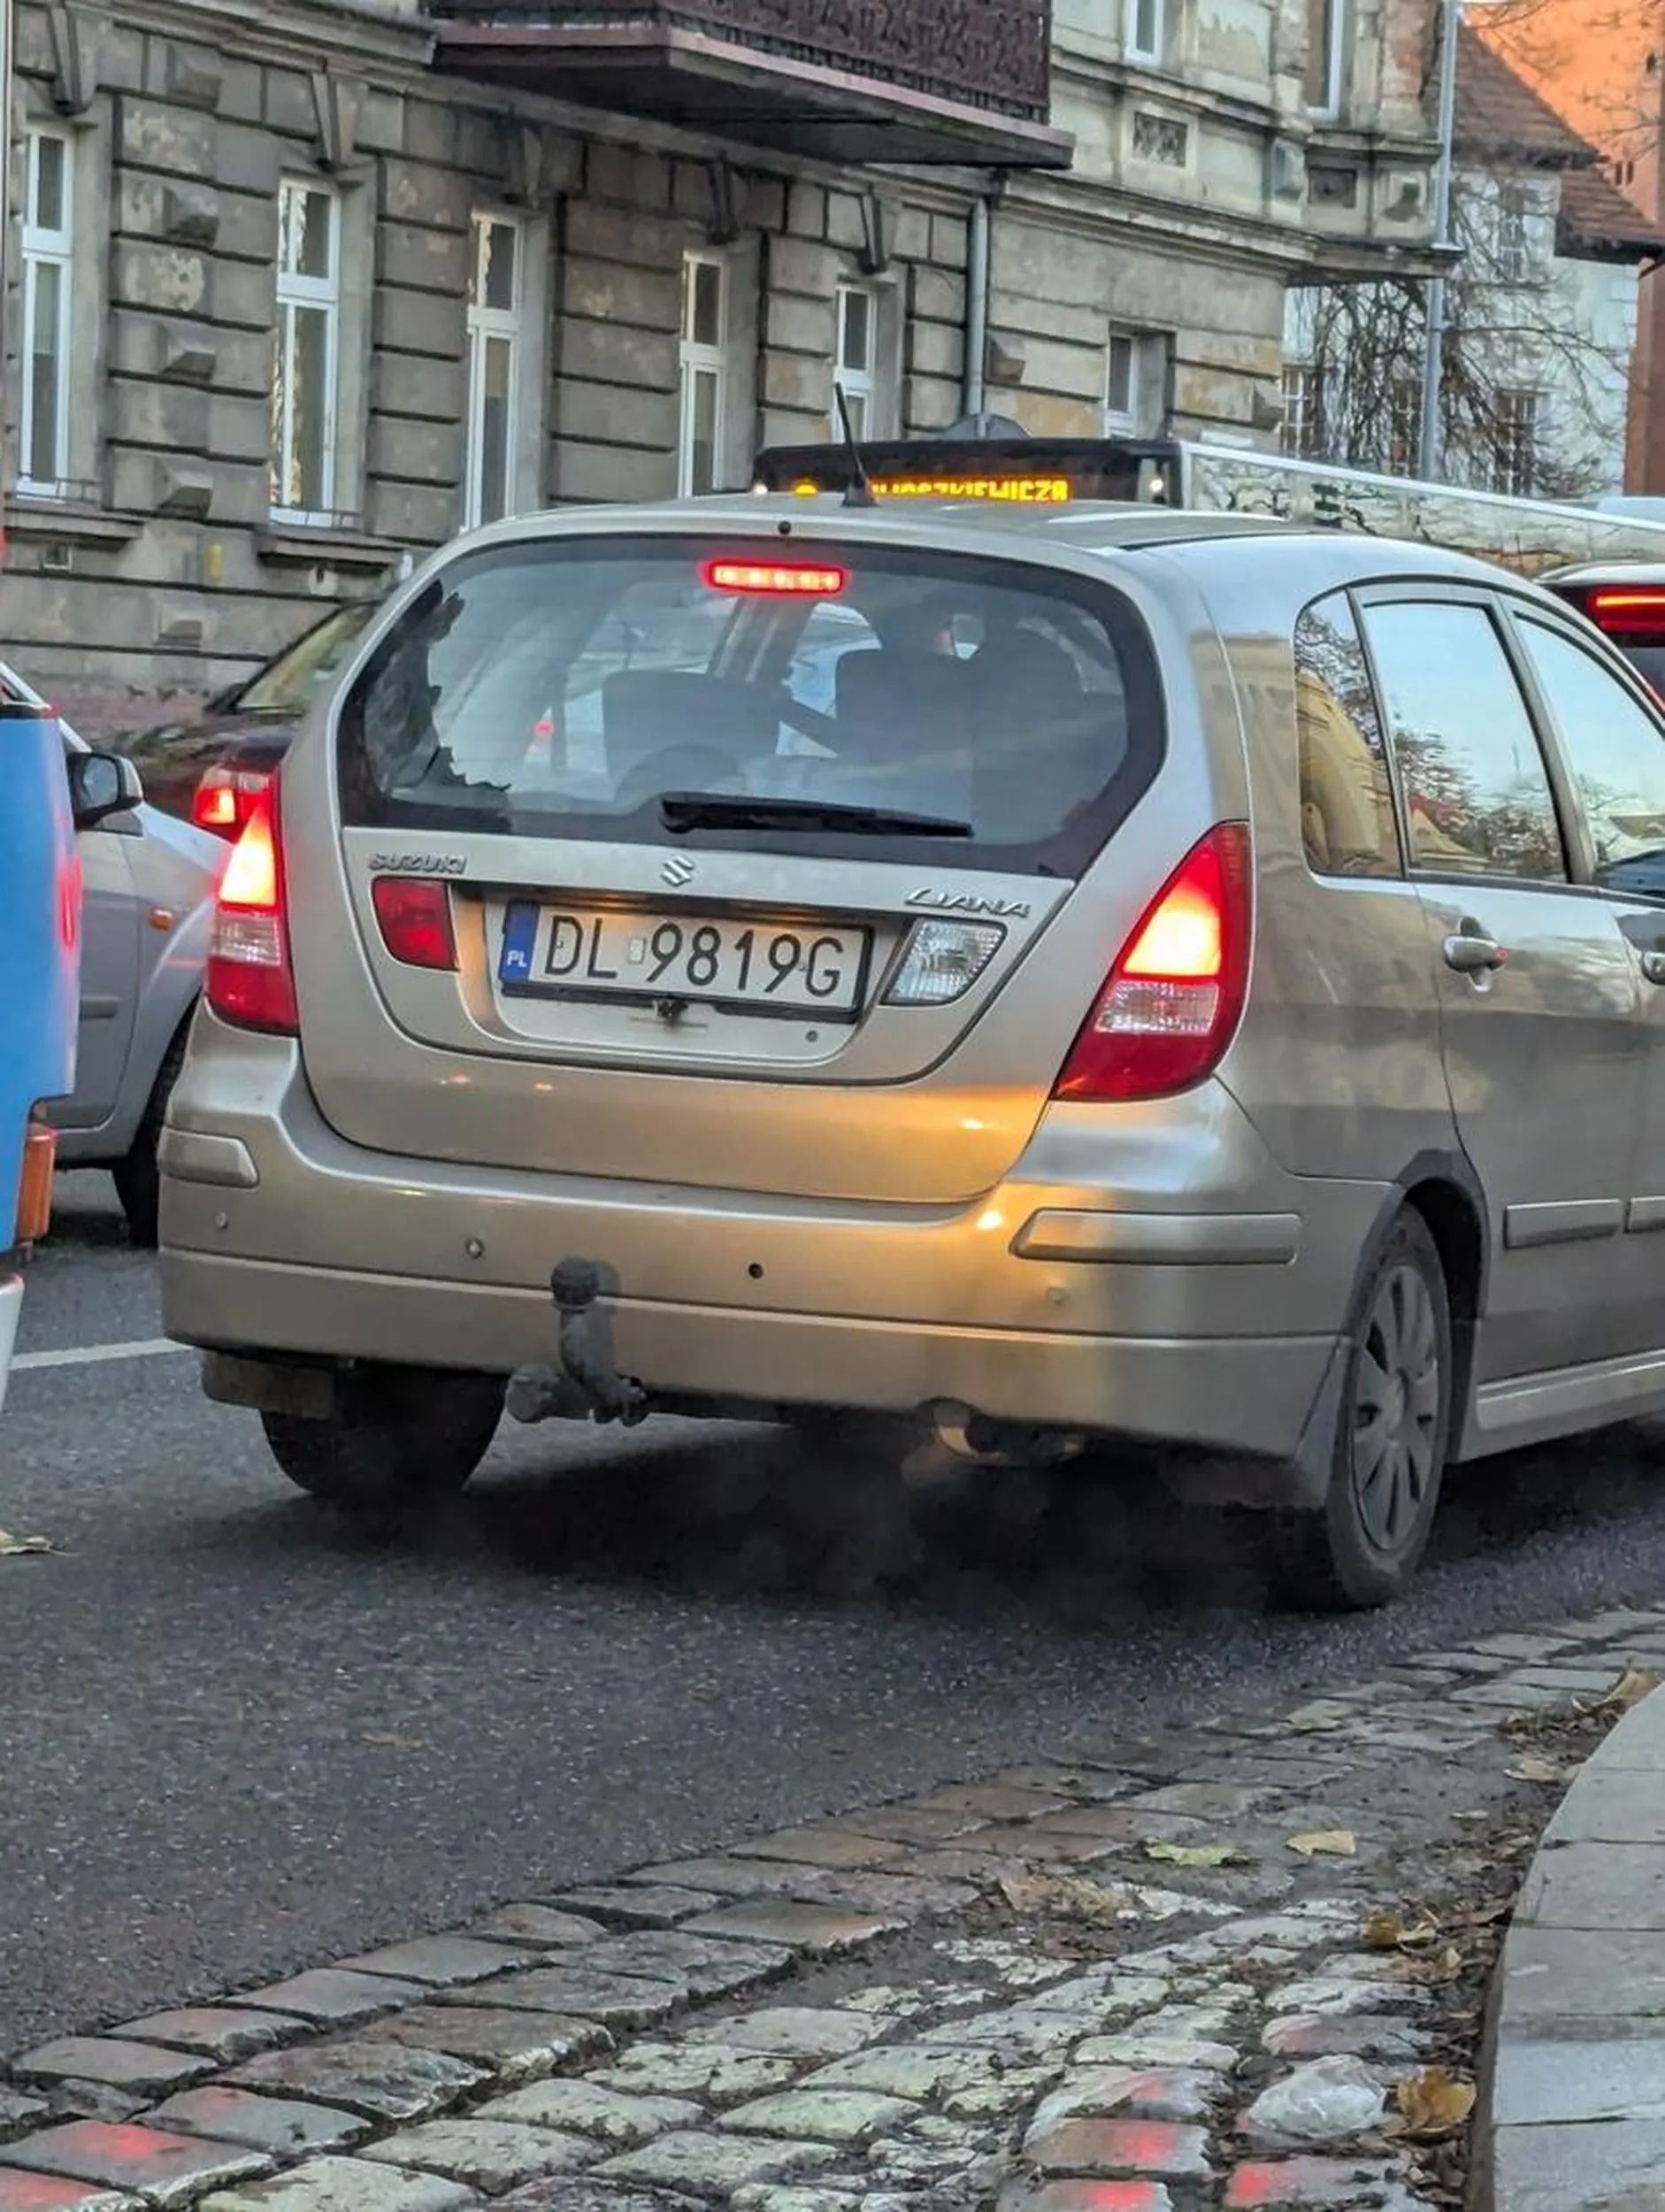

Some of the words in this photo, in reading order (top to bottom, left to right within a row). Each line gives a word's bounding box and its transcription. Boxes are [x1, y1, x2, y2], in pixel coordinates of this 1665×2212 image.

[369, 852, 468, 875] SUZUKI
[904, 888, 1032, 918] LIANA
[507, 949, 527, 968] PL
[544, 915, 618, 979] DL
[646, 922, 844, 998] 9819G
